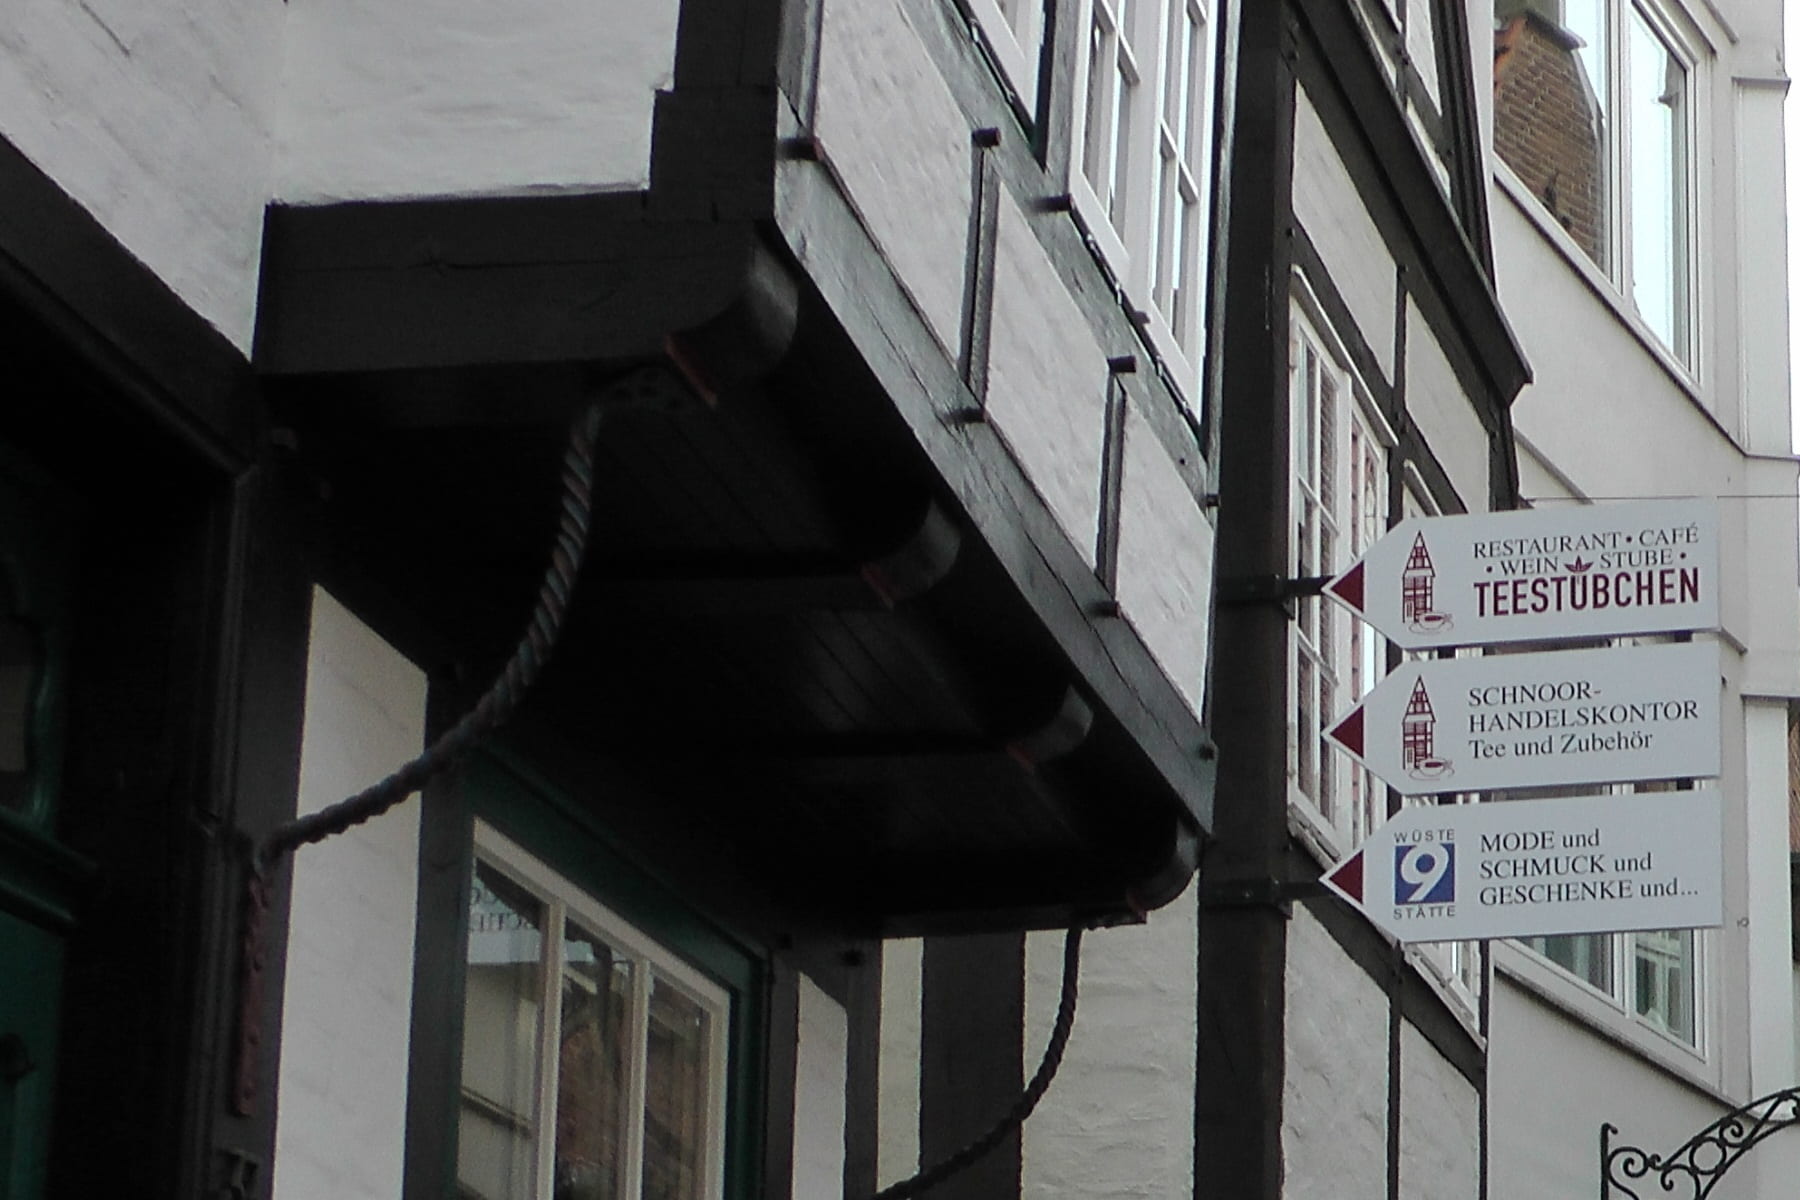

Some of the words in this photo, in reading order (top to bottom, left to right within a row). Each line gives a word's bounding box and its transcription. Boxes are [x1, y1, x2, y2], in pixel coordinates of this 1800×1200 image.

[1473, 532, 1622, 560] RESTAURANT
[1638, 522, 1699, 546] CAFÉ
[1500, 556, 1559, 575] WEIN
[1600, 550, 1674, 569] STUBE
[1473, 567, 1699, 618] TEESTÜBCHEN
[1468, 681, 1602, 707] SCHNOOR-
[1469, 700, 1699, 733] HANDELSKONTOR
[1468, 738, 1506, 759] Tee
[1513, 735, 1553, 755] und
[1560, 731, 1654, 754] Zubehör
[1393, 829, 1455, 844] WÜSTE
[1480, 831, 1555, 852] MODE
[1562, 828, 1600, 848] und
[1400, 844, 1449, 904] 9
[1480, 855, 1606, 879] SCHMUCK
[1613, 851, 1652, 872] und
[1480, 880, 1634, 906] GESCHENKE
[1393, 904, 1456, 920] STÄTTE
